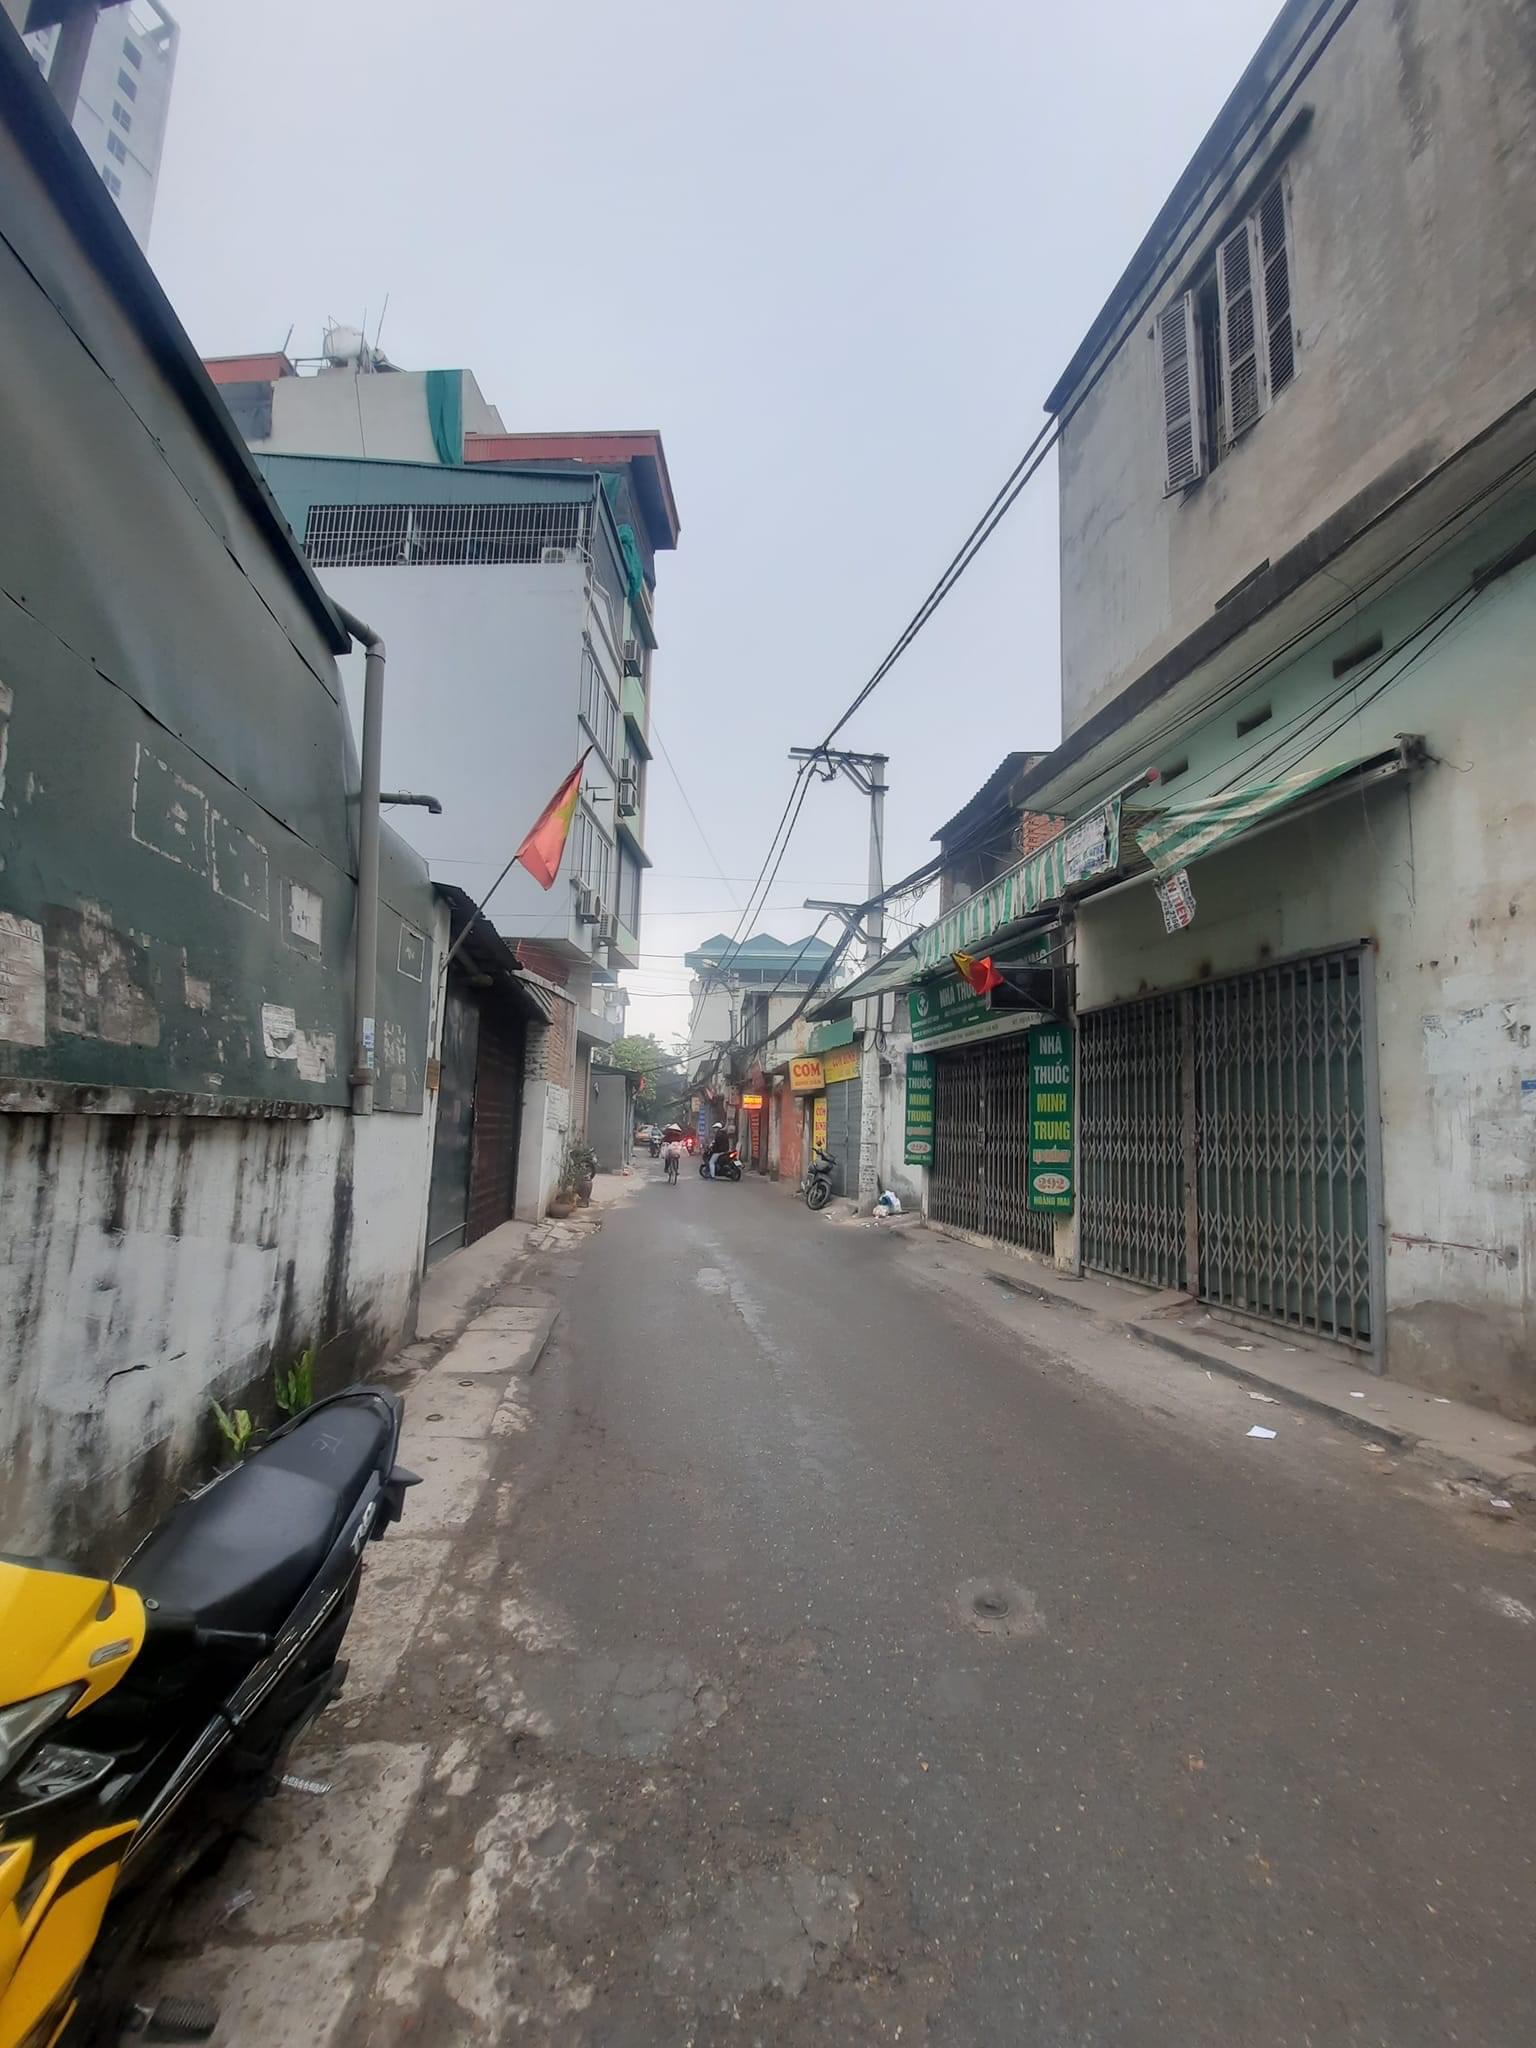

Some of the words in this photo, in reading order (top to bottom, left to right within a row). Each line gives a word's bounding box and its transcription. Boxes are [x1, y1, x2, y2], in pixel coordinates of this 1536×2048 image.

[957, 981, 978, 1002] THU
[1039, 1034, 1063, 1055] NHÀ
[1033, 1060, 1070, 1085] THUỐC
[1036, 1093, 1067, 1113] MINH
[907, 1109, 932, 1122] TRUNG
[1033, 1120, 1070, 1141] TRUNG
[1036, 1176, 1066, 1190] 292
